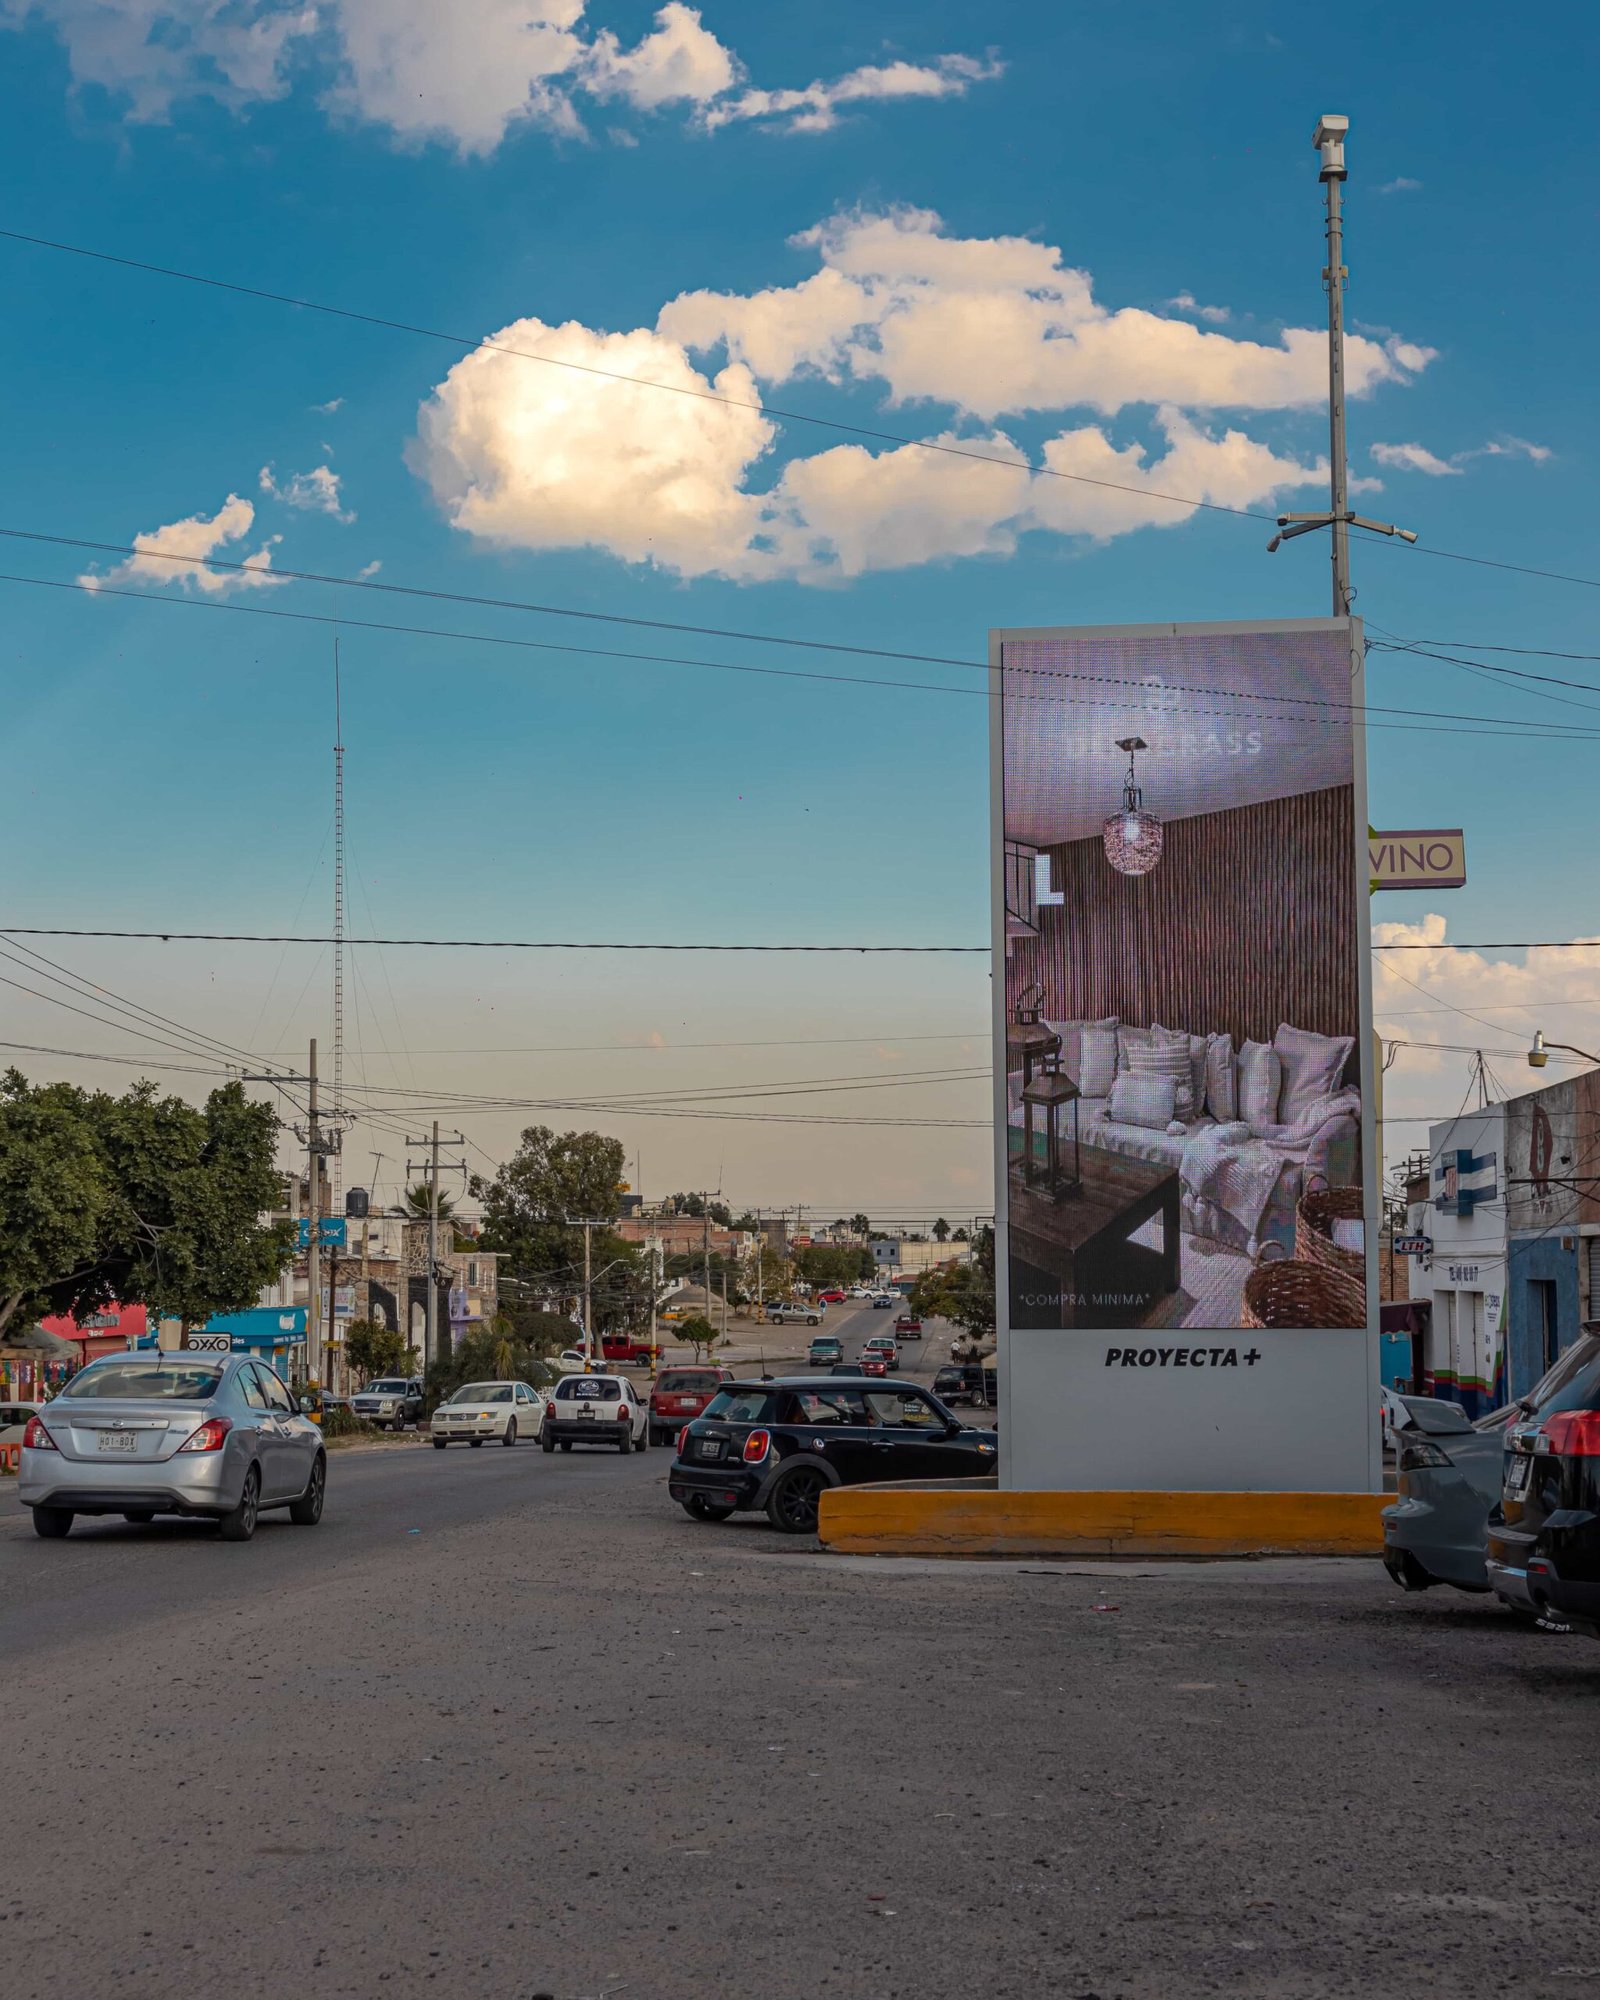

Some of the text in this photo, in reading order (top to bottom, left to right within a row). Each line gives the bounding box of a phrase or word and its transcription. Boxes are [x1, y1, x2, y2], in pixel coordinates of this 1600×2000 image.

[1369, 843, 1453, 873] VINO
[1401, 1242, 1425, 1251] LTH
[188, 1337, 229, 1350] OXXO
